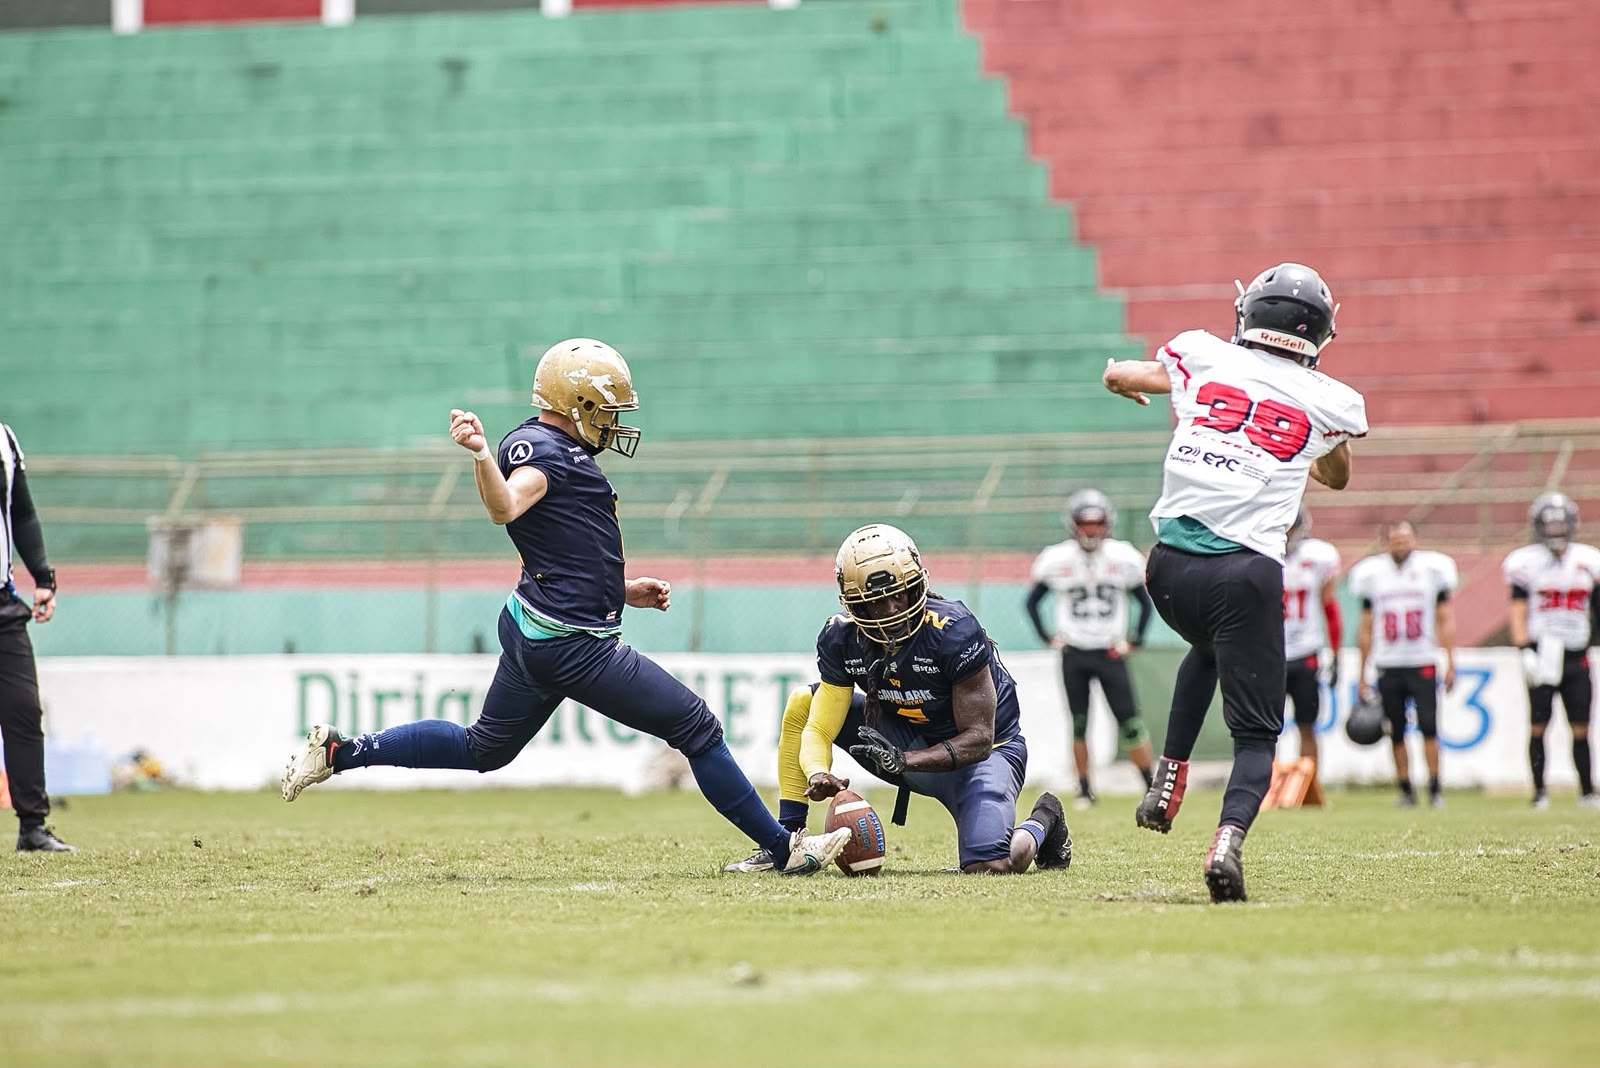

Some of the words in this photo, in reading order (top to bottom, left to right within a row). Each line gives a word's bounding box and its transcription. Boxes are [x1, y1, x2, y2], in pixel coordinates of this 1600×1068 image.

[1260, 331, 1306, 351] Riddell
[1157, 761, 1179, 810] UNDER
[858, 816, 871, 851] Wilson
